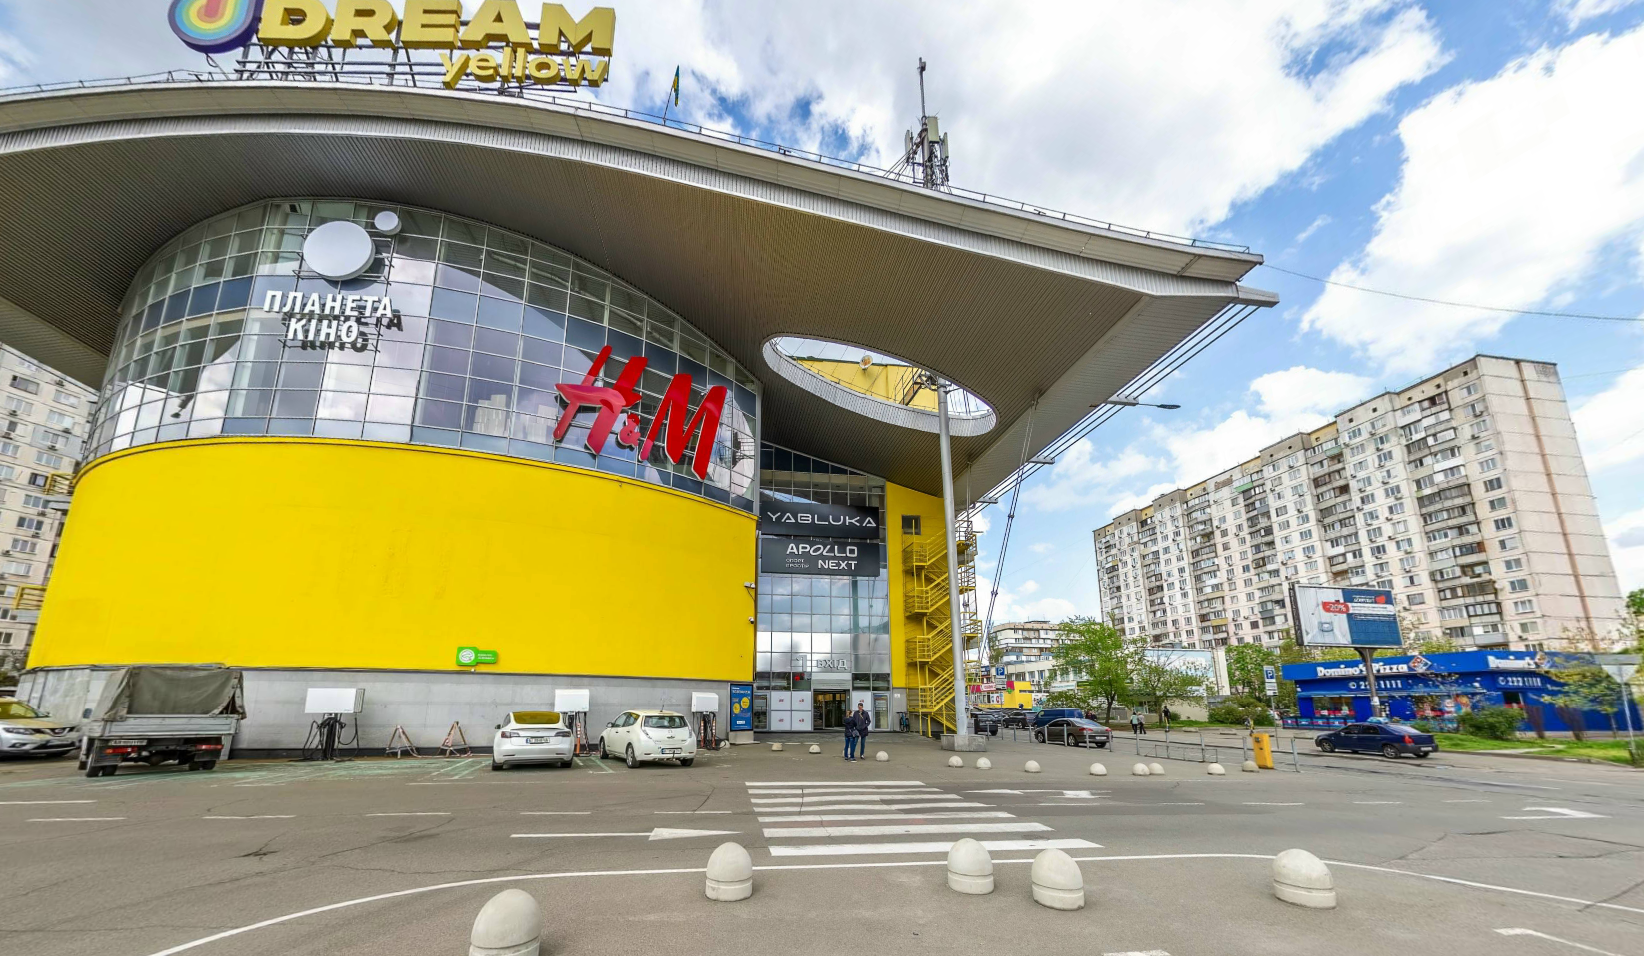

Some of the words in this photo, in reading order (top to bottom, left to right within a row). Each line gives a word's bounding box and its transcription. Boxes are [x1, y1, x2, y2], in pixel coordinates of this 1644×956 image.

[257, 0, 616, 56] DREAM
[439, 47, 608, 90] yellow
[263, 290, 393, 318] ПЛАНЕТА
[553, 345, 727, 480] H&M
[766, 511, 877, 528] YABLUKA
[786, 543, 858, 557] APOLLO
[818, 559, 858, 570] NEXT
[817, 659, 848, 670] ВХІД
[1316, 664, 1367, 677] Domino's
[1372, 662, 1409, 673] Pizza
